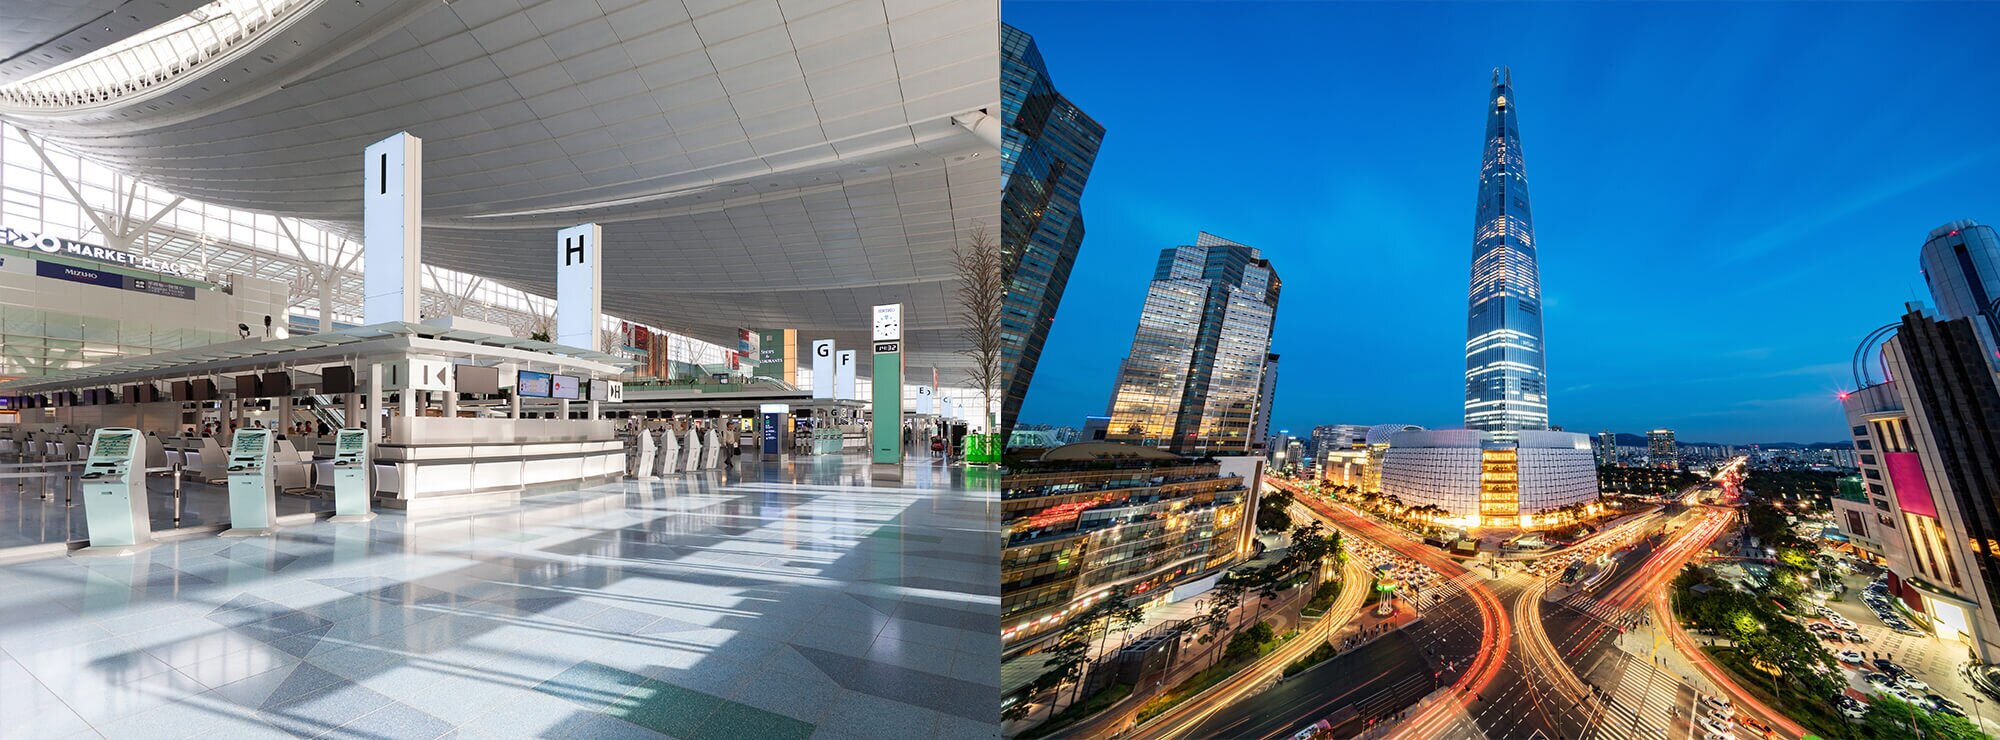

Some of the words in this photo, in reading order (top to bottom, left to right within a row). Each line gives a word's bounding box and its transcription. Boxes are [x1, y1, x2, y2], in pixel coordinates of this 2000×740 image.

[67, 241, 137, 265] MARKET
[142, 257, 189, 273] PLACE
[565, 234, 585, 266] H
[817, 343, 829, 357] G
[842, 354, 850, 365] F
[615, 385, 621, 399] H
